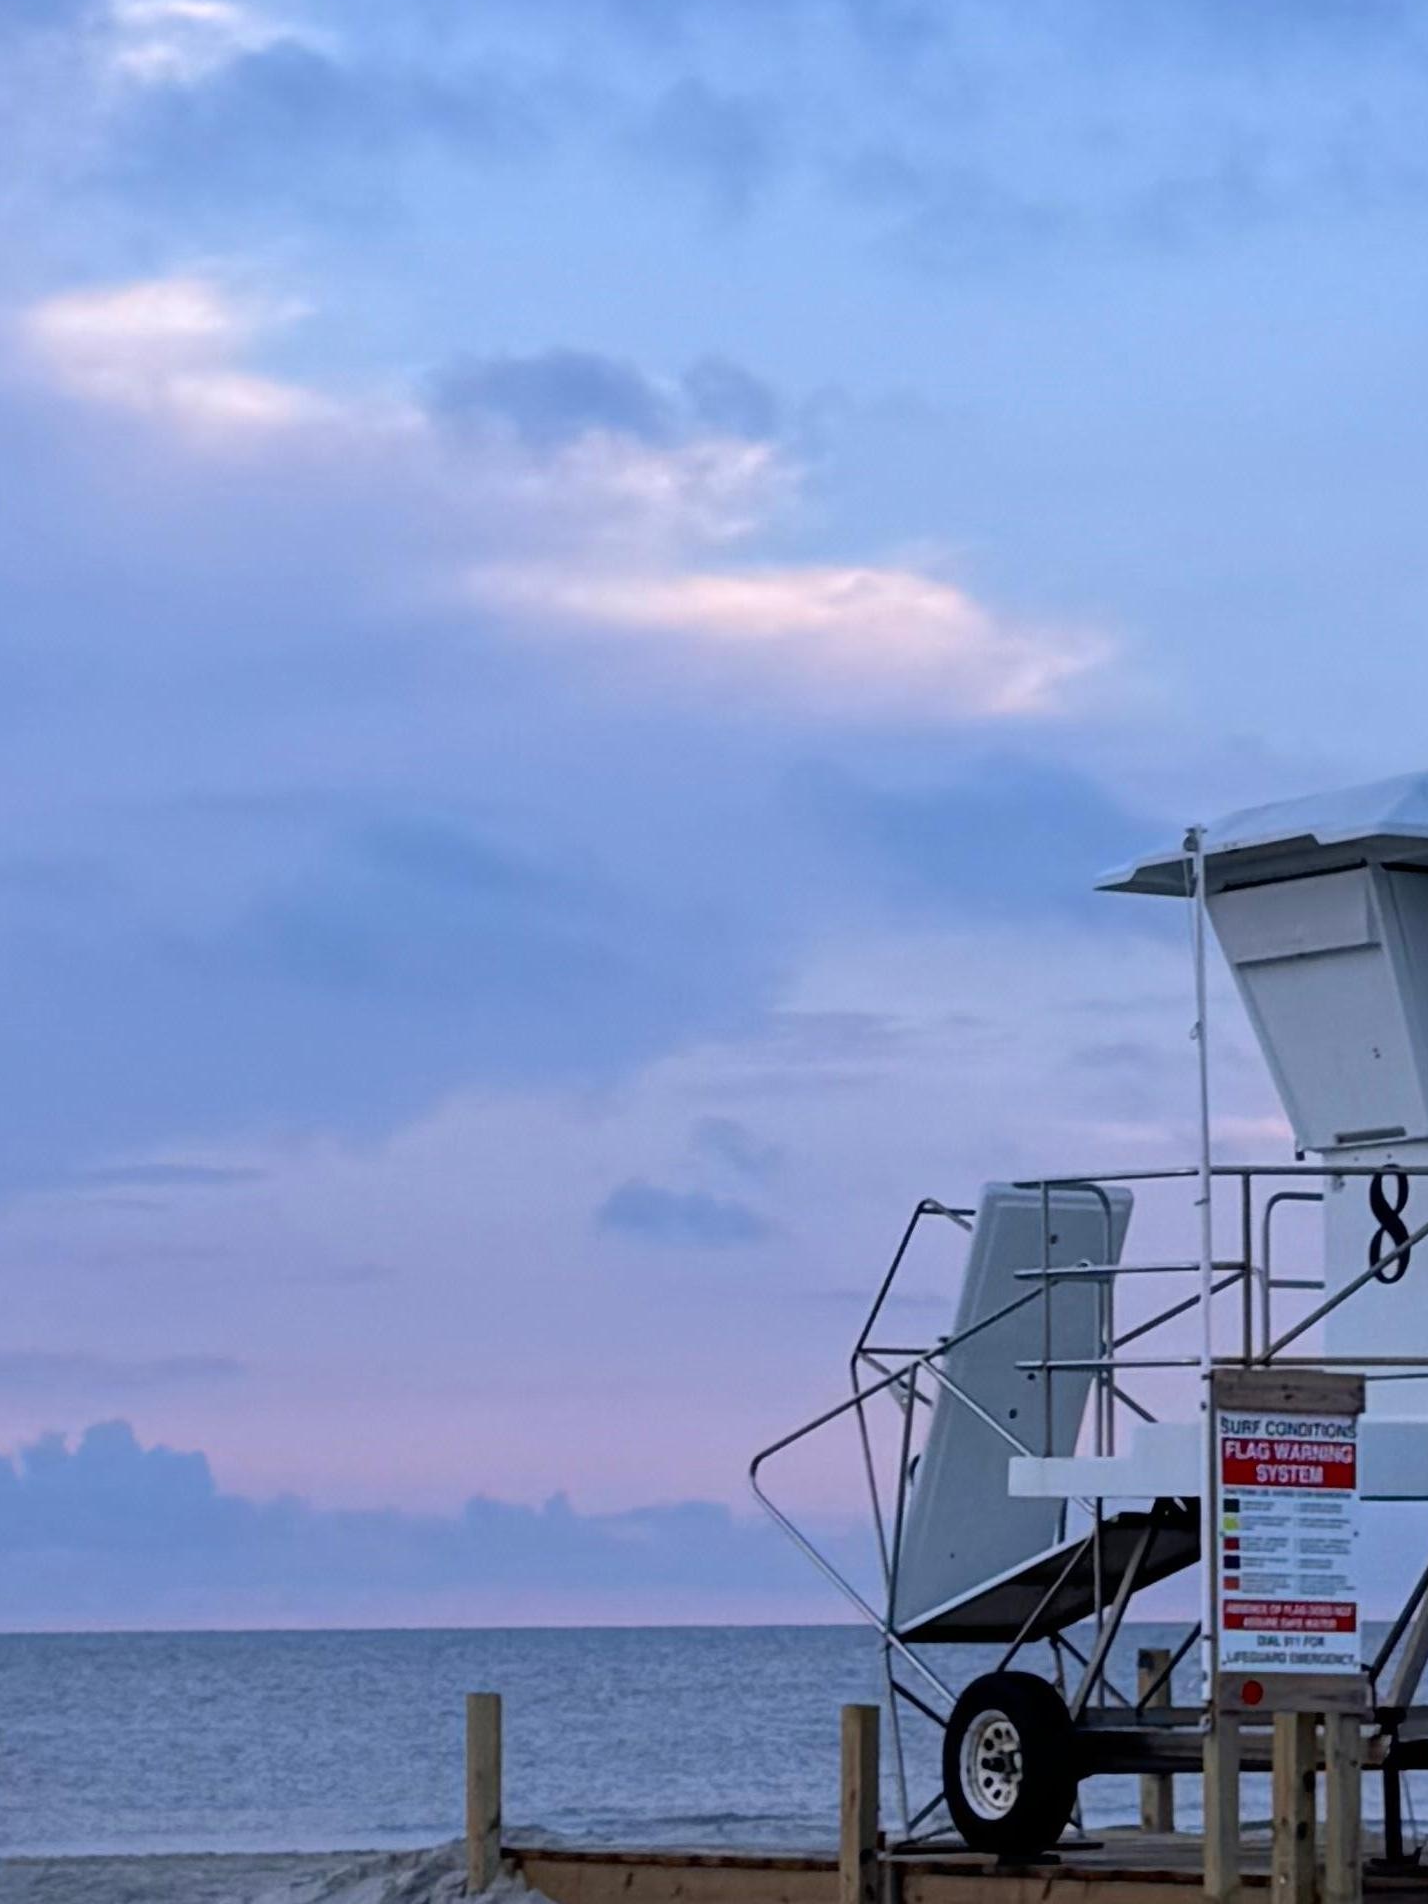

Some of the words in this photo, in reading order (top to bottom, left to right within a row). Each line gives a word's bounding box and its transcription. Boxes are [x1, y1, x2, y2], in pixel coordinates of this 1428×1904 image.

[1369, 1163, 1411, 1284] 8
[1220, 1416, 1260, 1434] SURF
[1265, 1421, 1357, 1439] CONDITIONS
[1225, 1440, 1271, 1460] FLAG
[1274, 1442, 1354, 1464] WARNING
[1256, 1464, 1324, 1483] SYSTEM
[1269, 1604, 1282, 1615] OF
[1257, 1635, 1281, 1647] DIAL
[1302, 1636, 1325, 1647] FOR
[1227, 1651, 1287, 1664] LIFEGUARD
[1289, 1652, 1355, 1665] EMERGENCY
